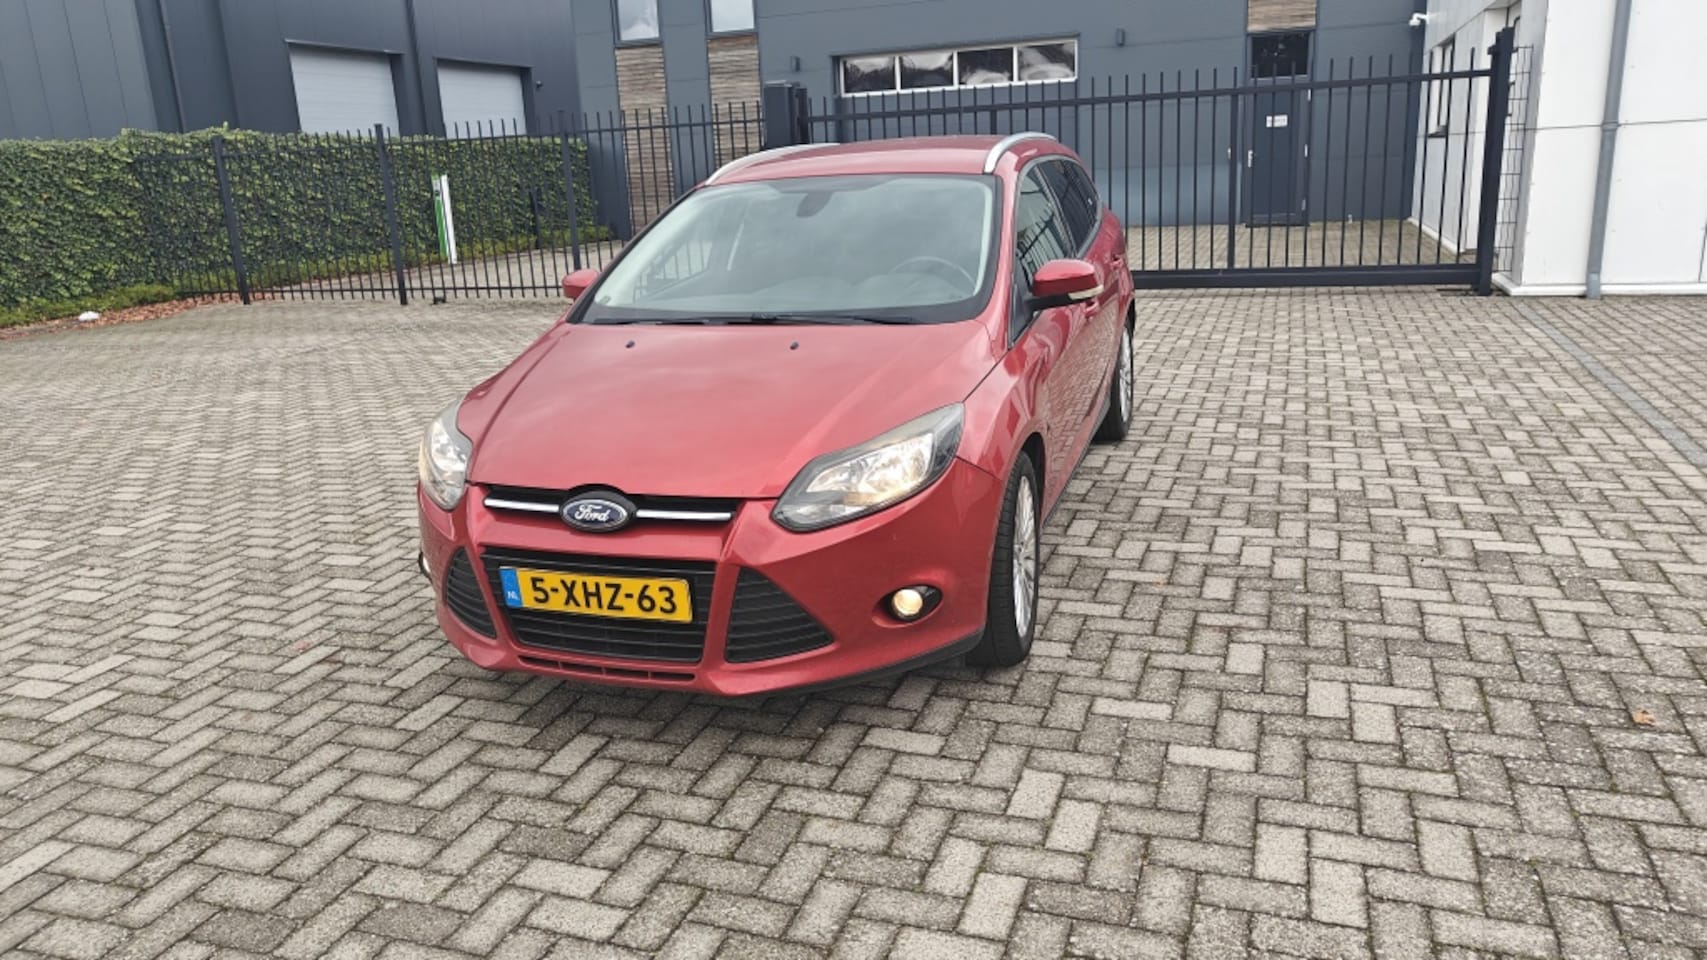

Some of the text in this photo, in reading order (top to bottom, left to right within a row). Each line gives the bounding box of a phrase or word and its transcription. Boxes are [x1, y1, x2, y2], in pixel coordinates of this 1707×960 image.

[574, 504, 610, 522] Ford
[507, 590, 519, 601] NL
[530, 576, 677, 614] 5-XHZ-63
